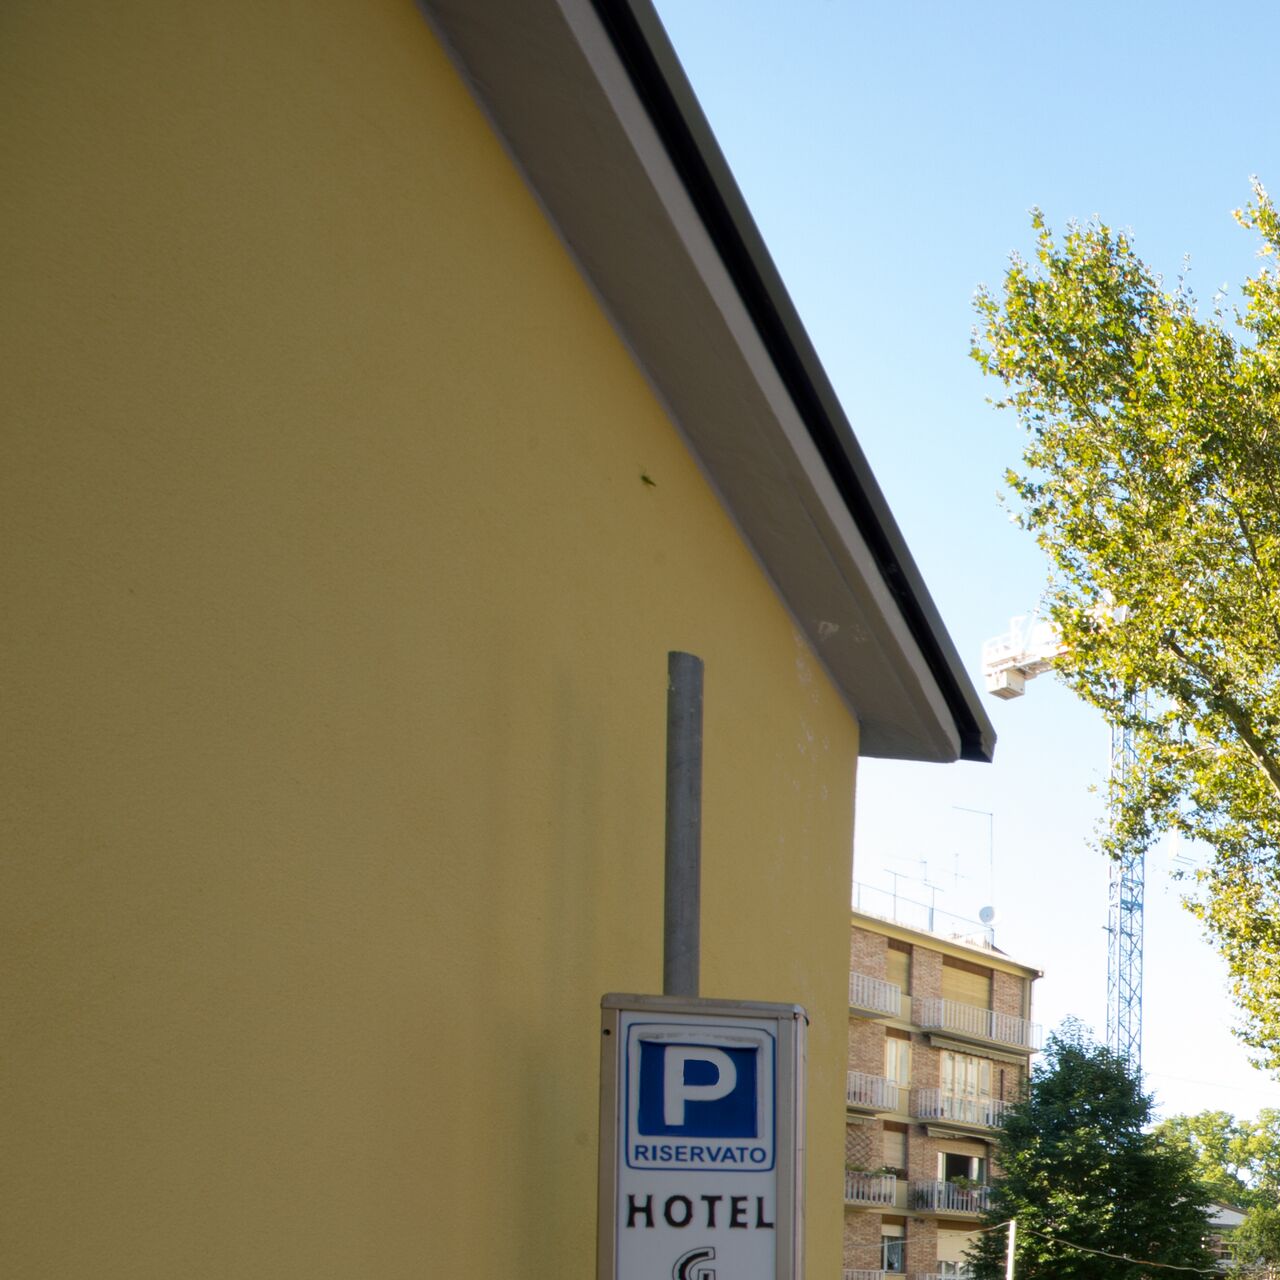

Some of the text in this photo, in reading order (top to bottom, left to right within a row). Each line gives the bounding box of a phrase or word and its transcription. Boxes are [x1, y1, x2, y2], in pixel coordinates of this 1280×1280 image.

[664, 1045, 737, 1126] P
[634, 1144, 767, 1164] RISERVATO
[626, 1193, 775, 1230] HOTEL
